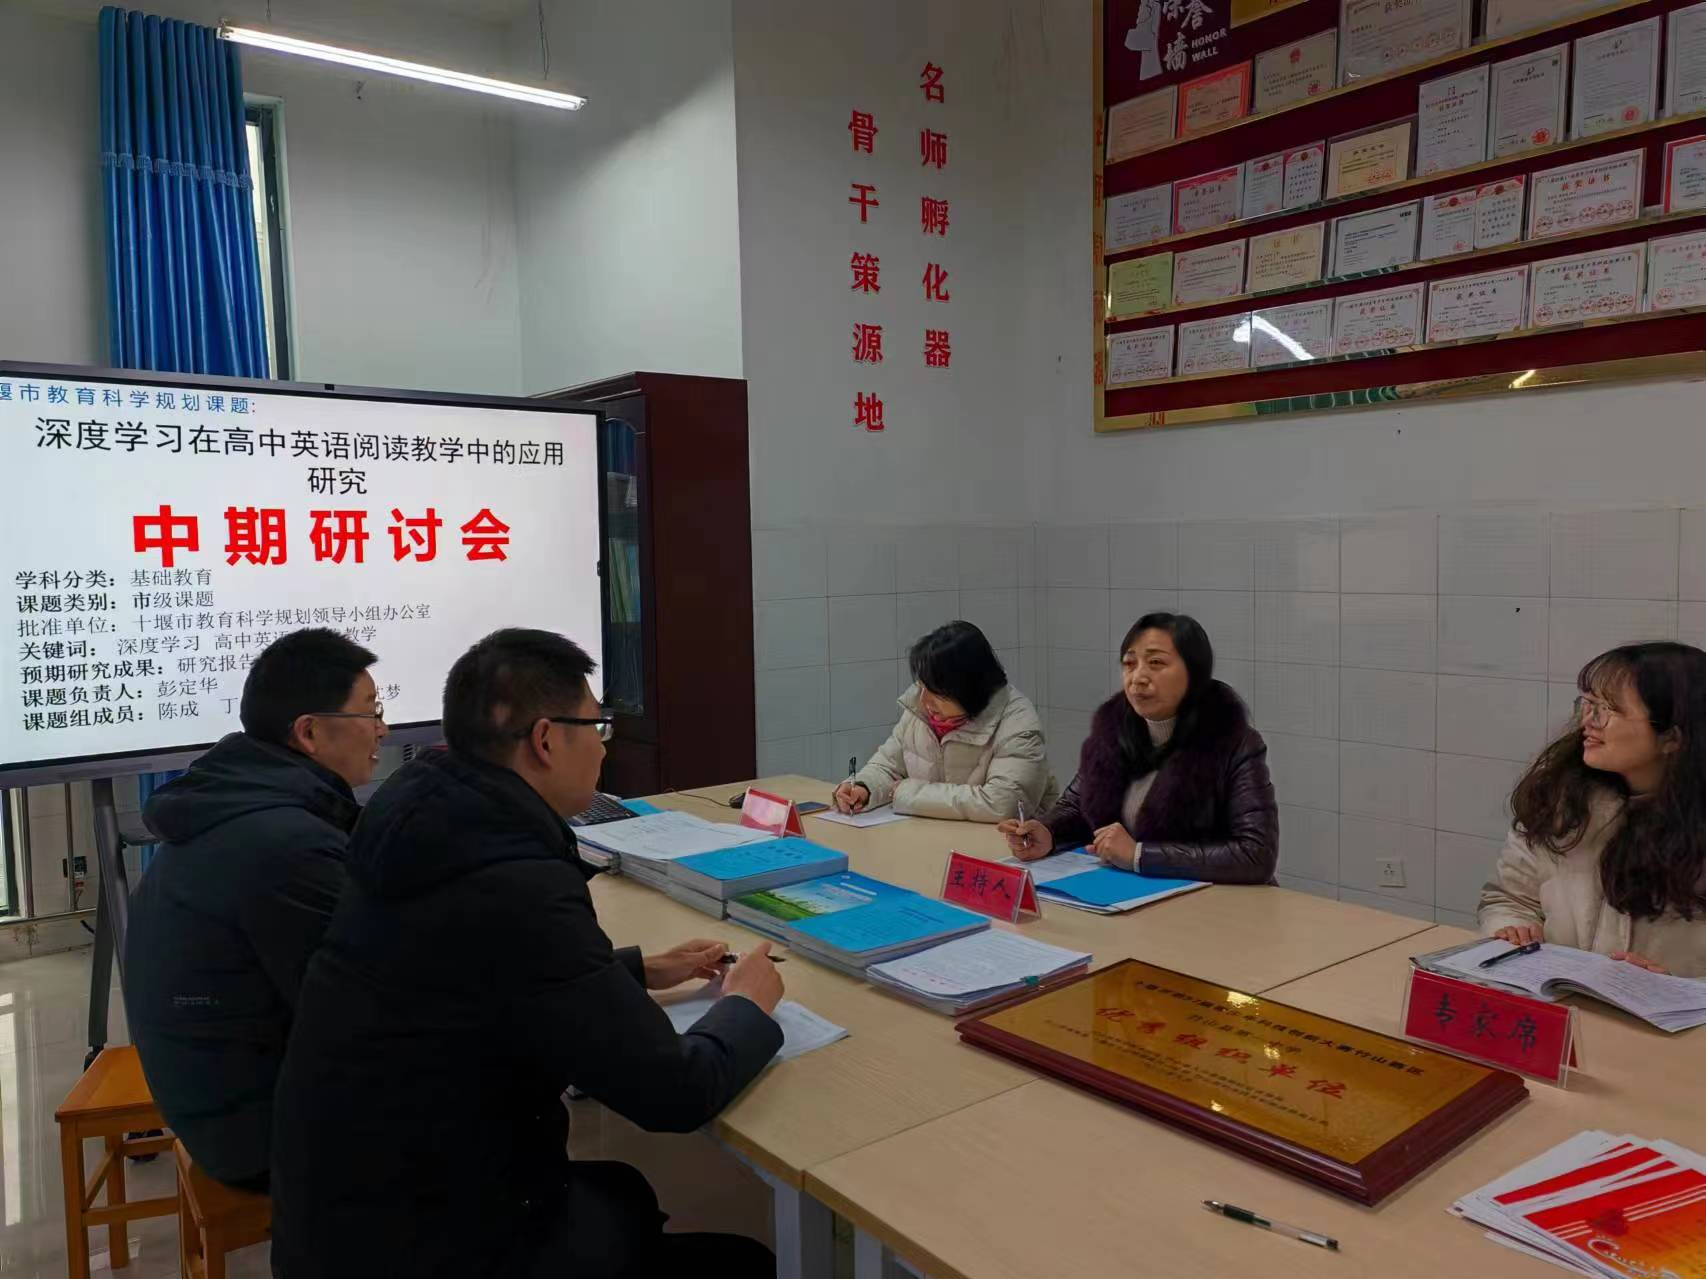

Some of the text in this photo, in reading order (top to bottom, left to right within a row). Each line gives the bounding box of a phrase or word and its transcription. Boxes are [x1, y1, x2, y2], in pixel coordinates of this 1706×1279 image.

[1191, 28, 1227, 48] HONOR
[1191, 47, 1219, 62] WALL
[920, 62, 951, 367] 名师孵化器
[848, 110, 884, 431] 骨干策源地
[35, 417, 564, 466] 深度学习在高中英语阅读教学中的应用
[307, 467, 367, 495] 研究
[133, 504, 511, 568] 中期研讨会
[949, 862, 1011, 899] 主持人
[1432, 991, 1537, 1056] 专家席
